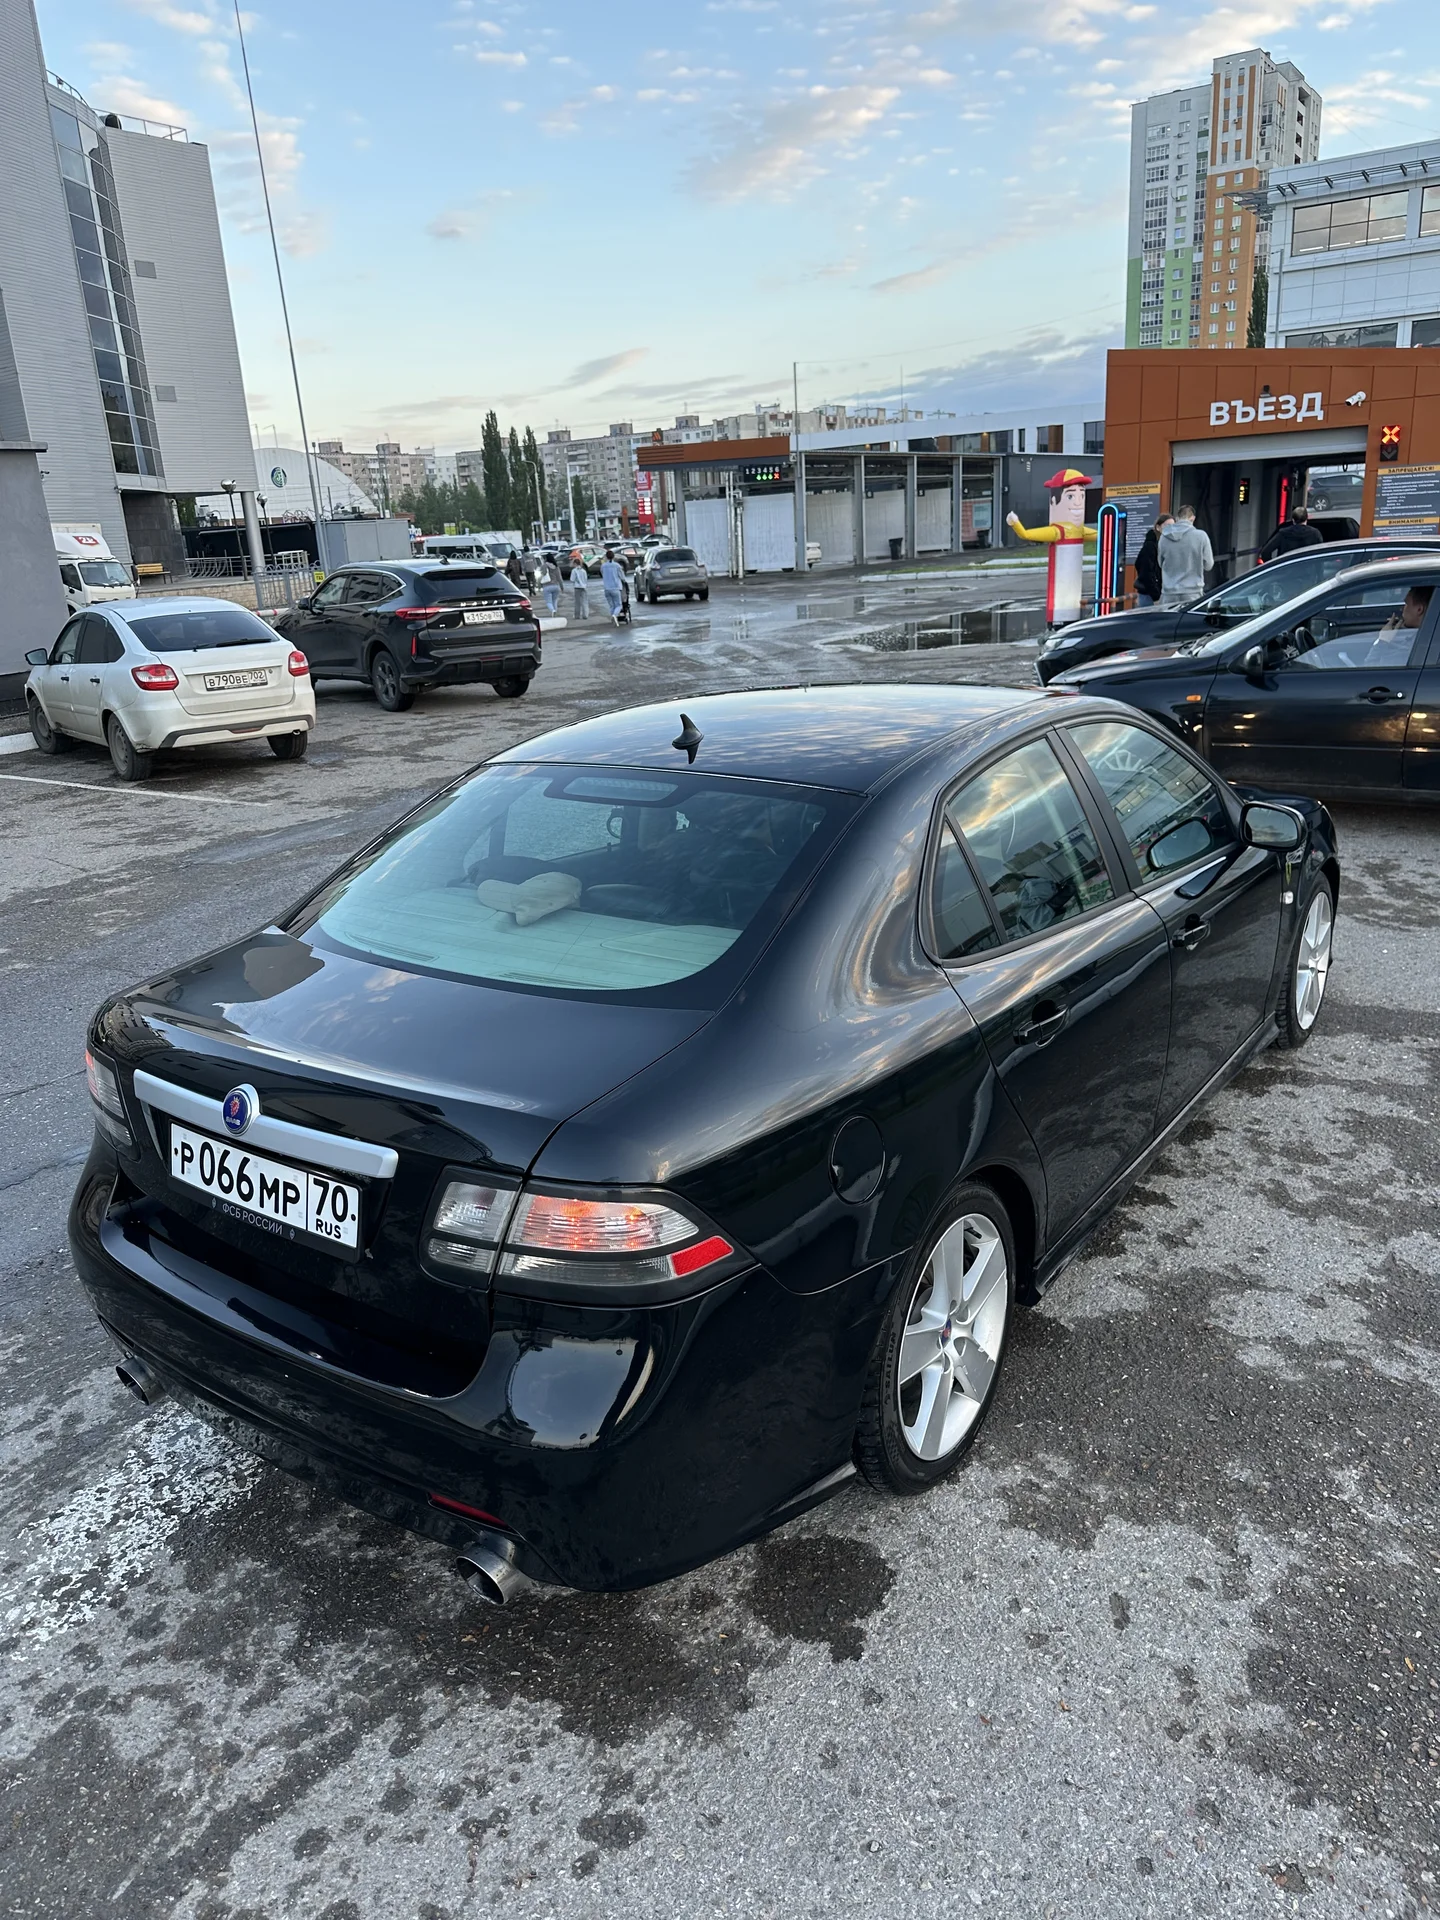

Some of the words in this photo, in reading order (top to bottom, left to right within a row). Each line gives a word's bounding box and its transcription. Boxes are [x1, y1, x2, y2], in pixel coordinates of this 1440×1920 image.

[1209, 391, 1324, 426] ВЪЕЗД
[751, 467, 756, 475] 2
[248, 671, 264, 680] 702
[311, 1177, 349, 1223] 70
[222, 1202, 241, 1222] ФСБ
[241, 1210, 283, 1236] РОССИИ
[315, 1218, 342, 1240] RUS
